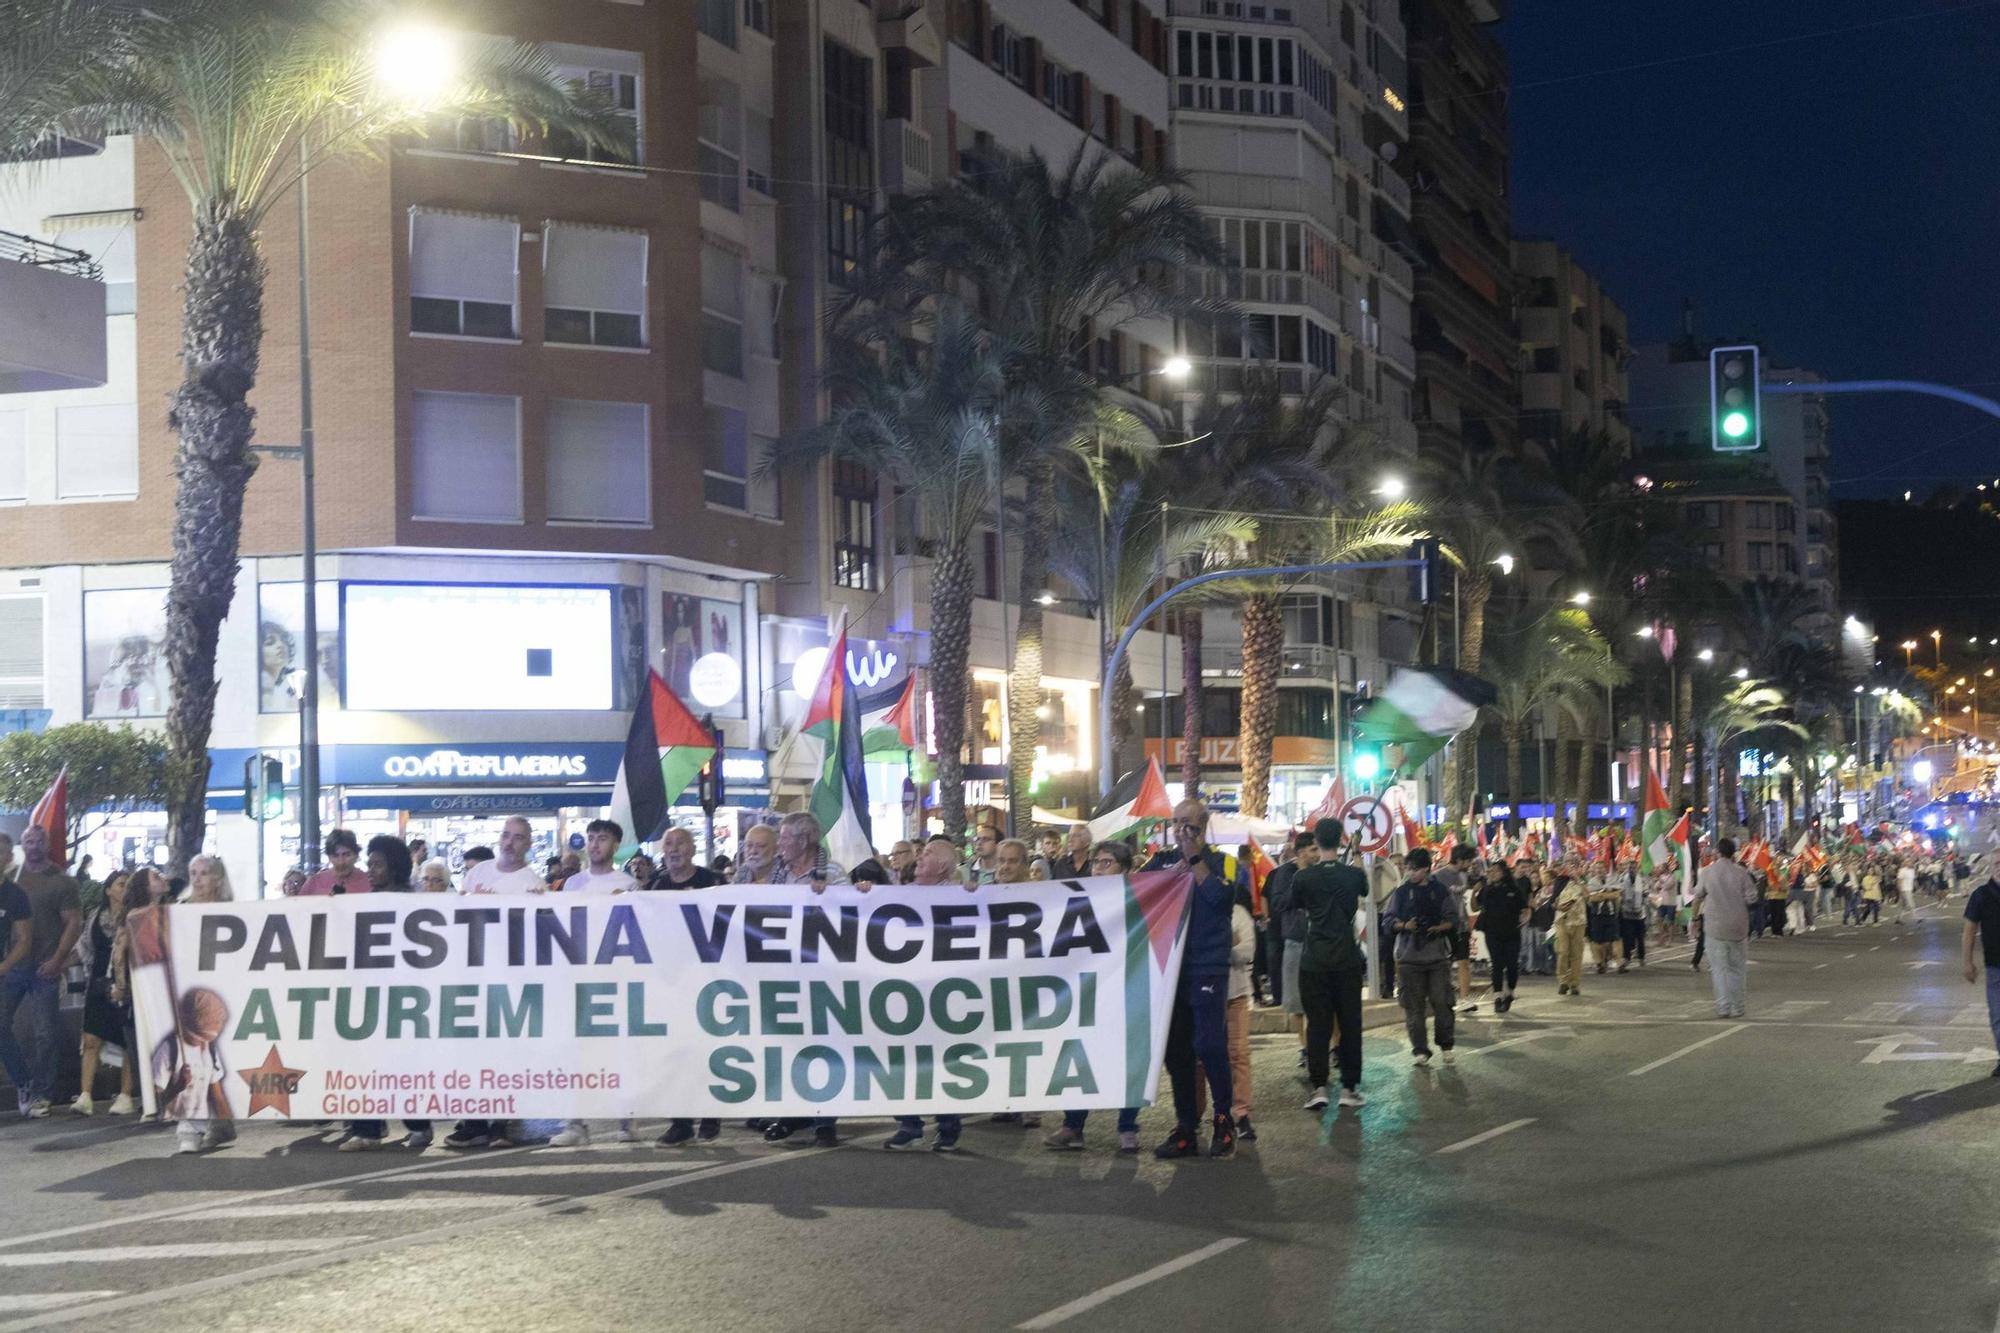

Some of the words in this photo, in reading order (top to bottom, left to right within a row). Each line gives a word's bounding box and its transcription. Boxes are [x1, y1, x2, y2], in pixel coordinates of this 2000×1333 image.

[199, 905, 653, 971] PALESTINA
[680, 881, 1111, 964] VENCERÀ
[233, 984, 543, 1040] ATUREM
[574, 982, 667, 1037] EL
[696, 972, 1097, 1037] GENOCIDI
[249, 1072, 299, 1094] MRG
[325, 1069, 435, 1090] Moviment
[443, 1070, 471, 1089] de
[479, 1068, 621, 1089] Resistència
[709, 1039, 1099, 1103] SIONISTA
[322, 1094, 395, 1114] Global
